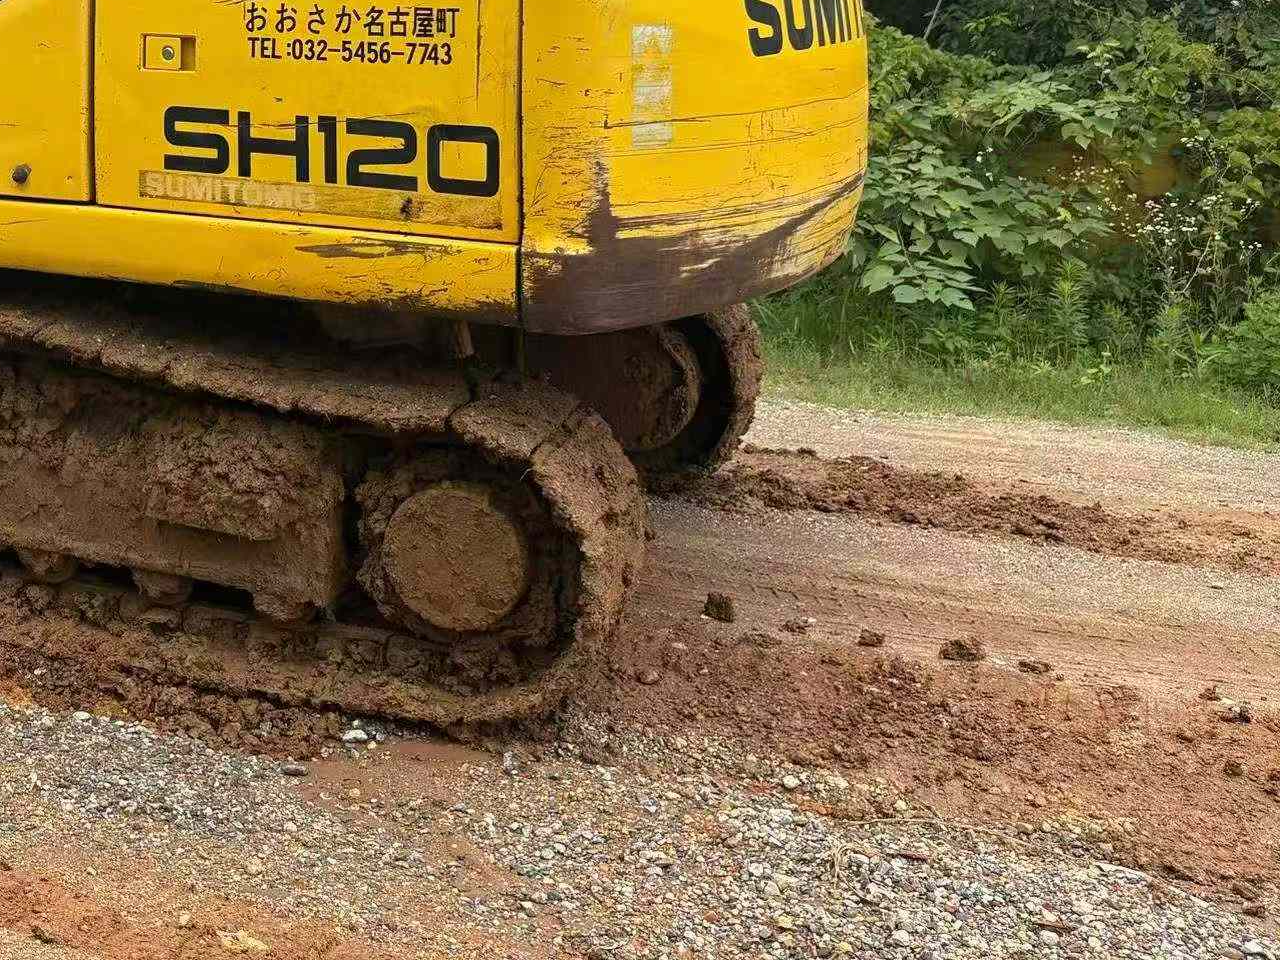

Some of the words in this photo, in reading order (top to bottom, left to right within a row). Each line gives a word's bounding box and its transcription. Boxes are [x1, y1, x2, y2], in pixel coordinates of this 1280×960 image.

[246, 2, 460, 38] おおさか名古屋町
[164, 106, 500, 198] SH120
